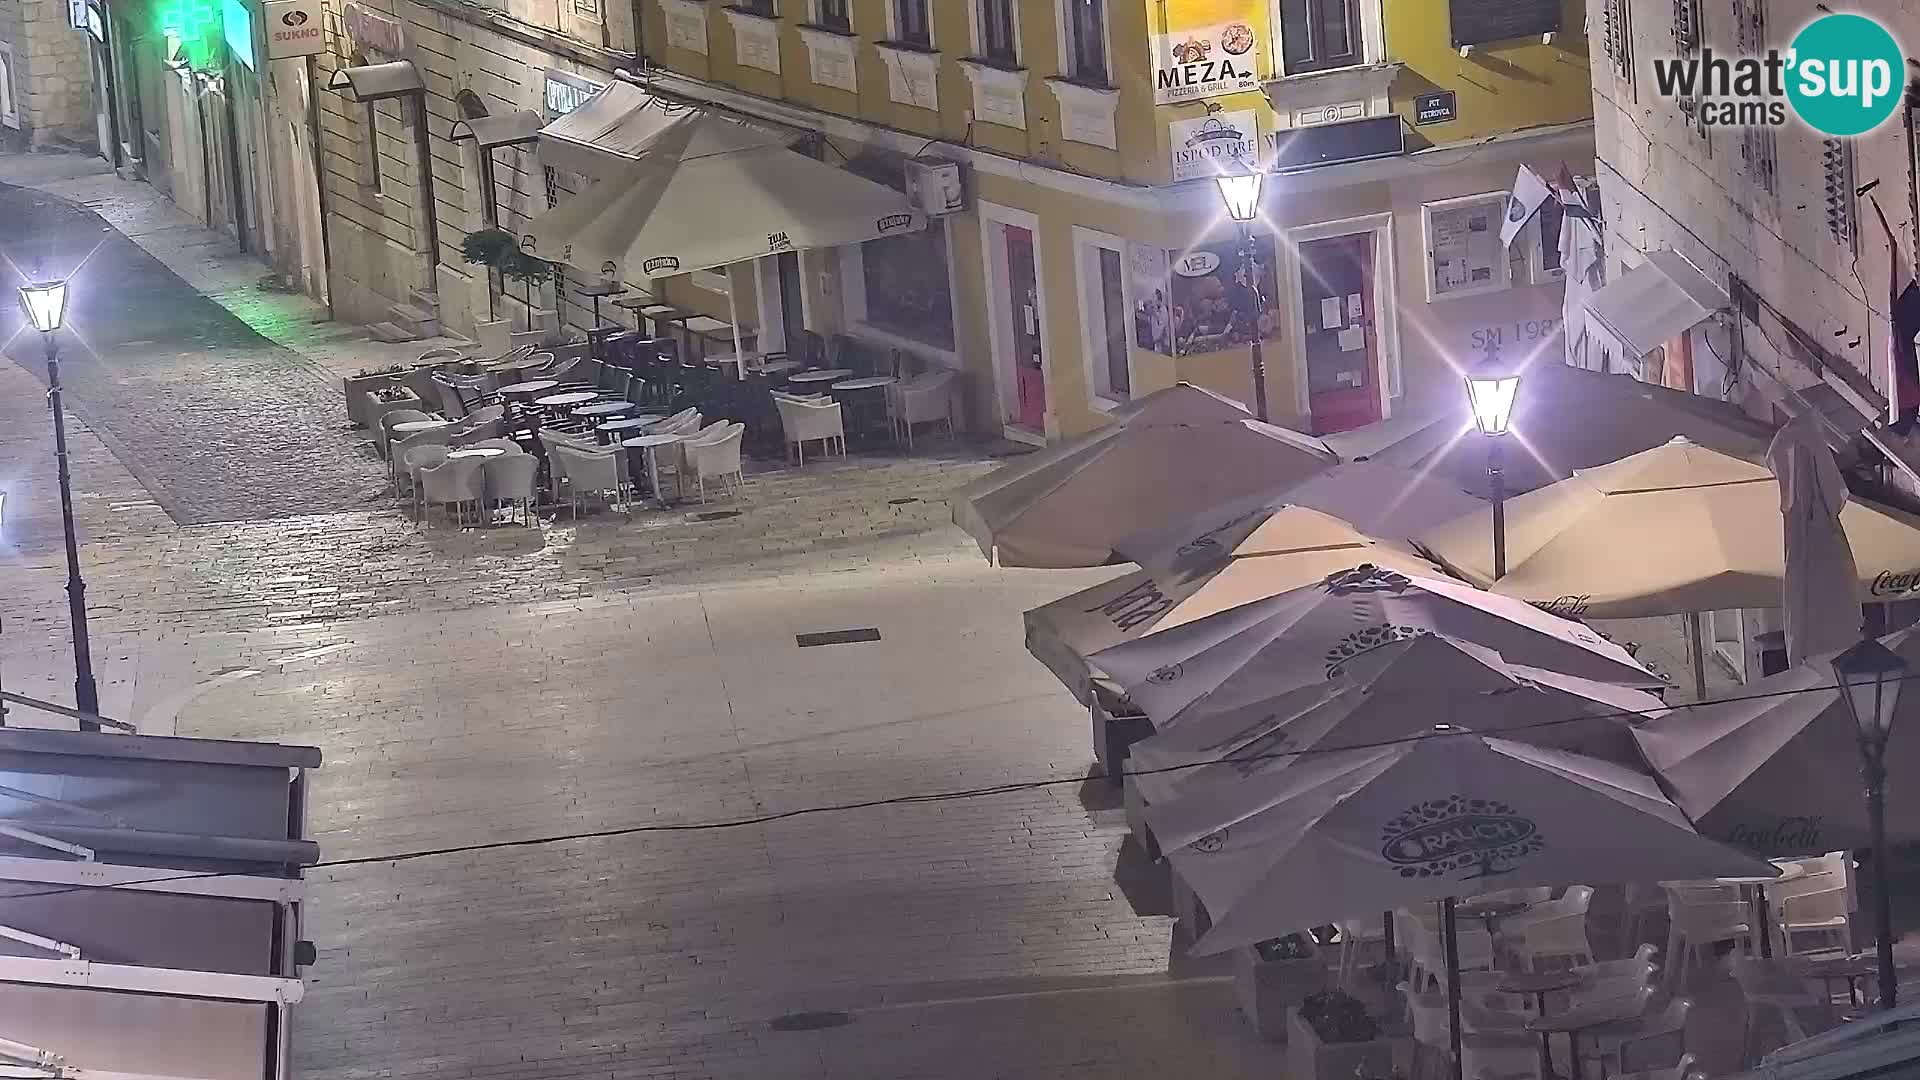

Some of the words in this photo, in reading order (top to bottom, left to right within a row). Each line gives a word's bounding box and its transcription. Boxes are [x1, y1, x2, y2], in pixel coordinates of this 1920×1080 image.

[273, 28, 319, 41] SUKNO
[1158, 60, 1236, 89] MEZA
[1167, 86, 1199, 98] PIZZERIA
[1207, 82, 1226, 92] GRILL
[1176, 145, 1222, 163] ISPOD
